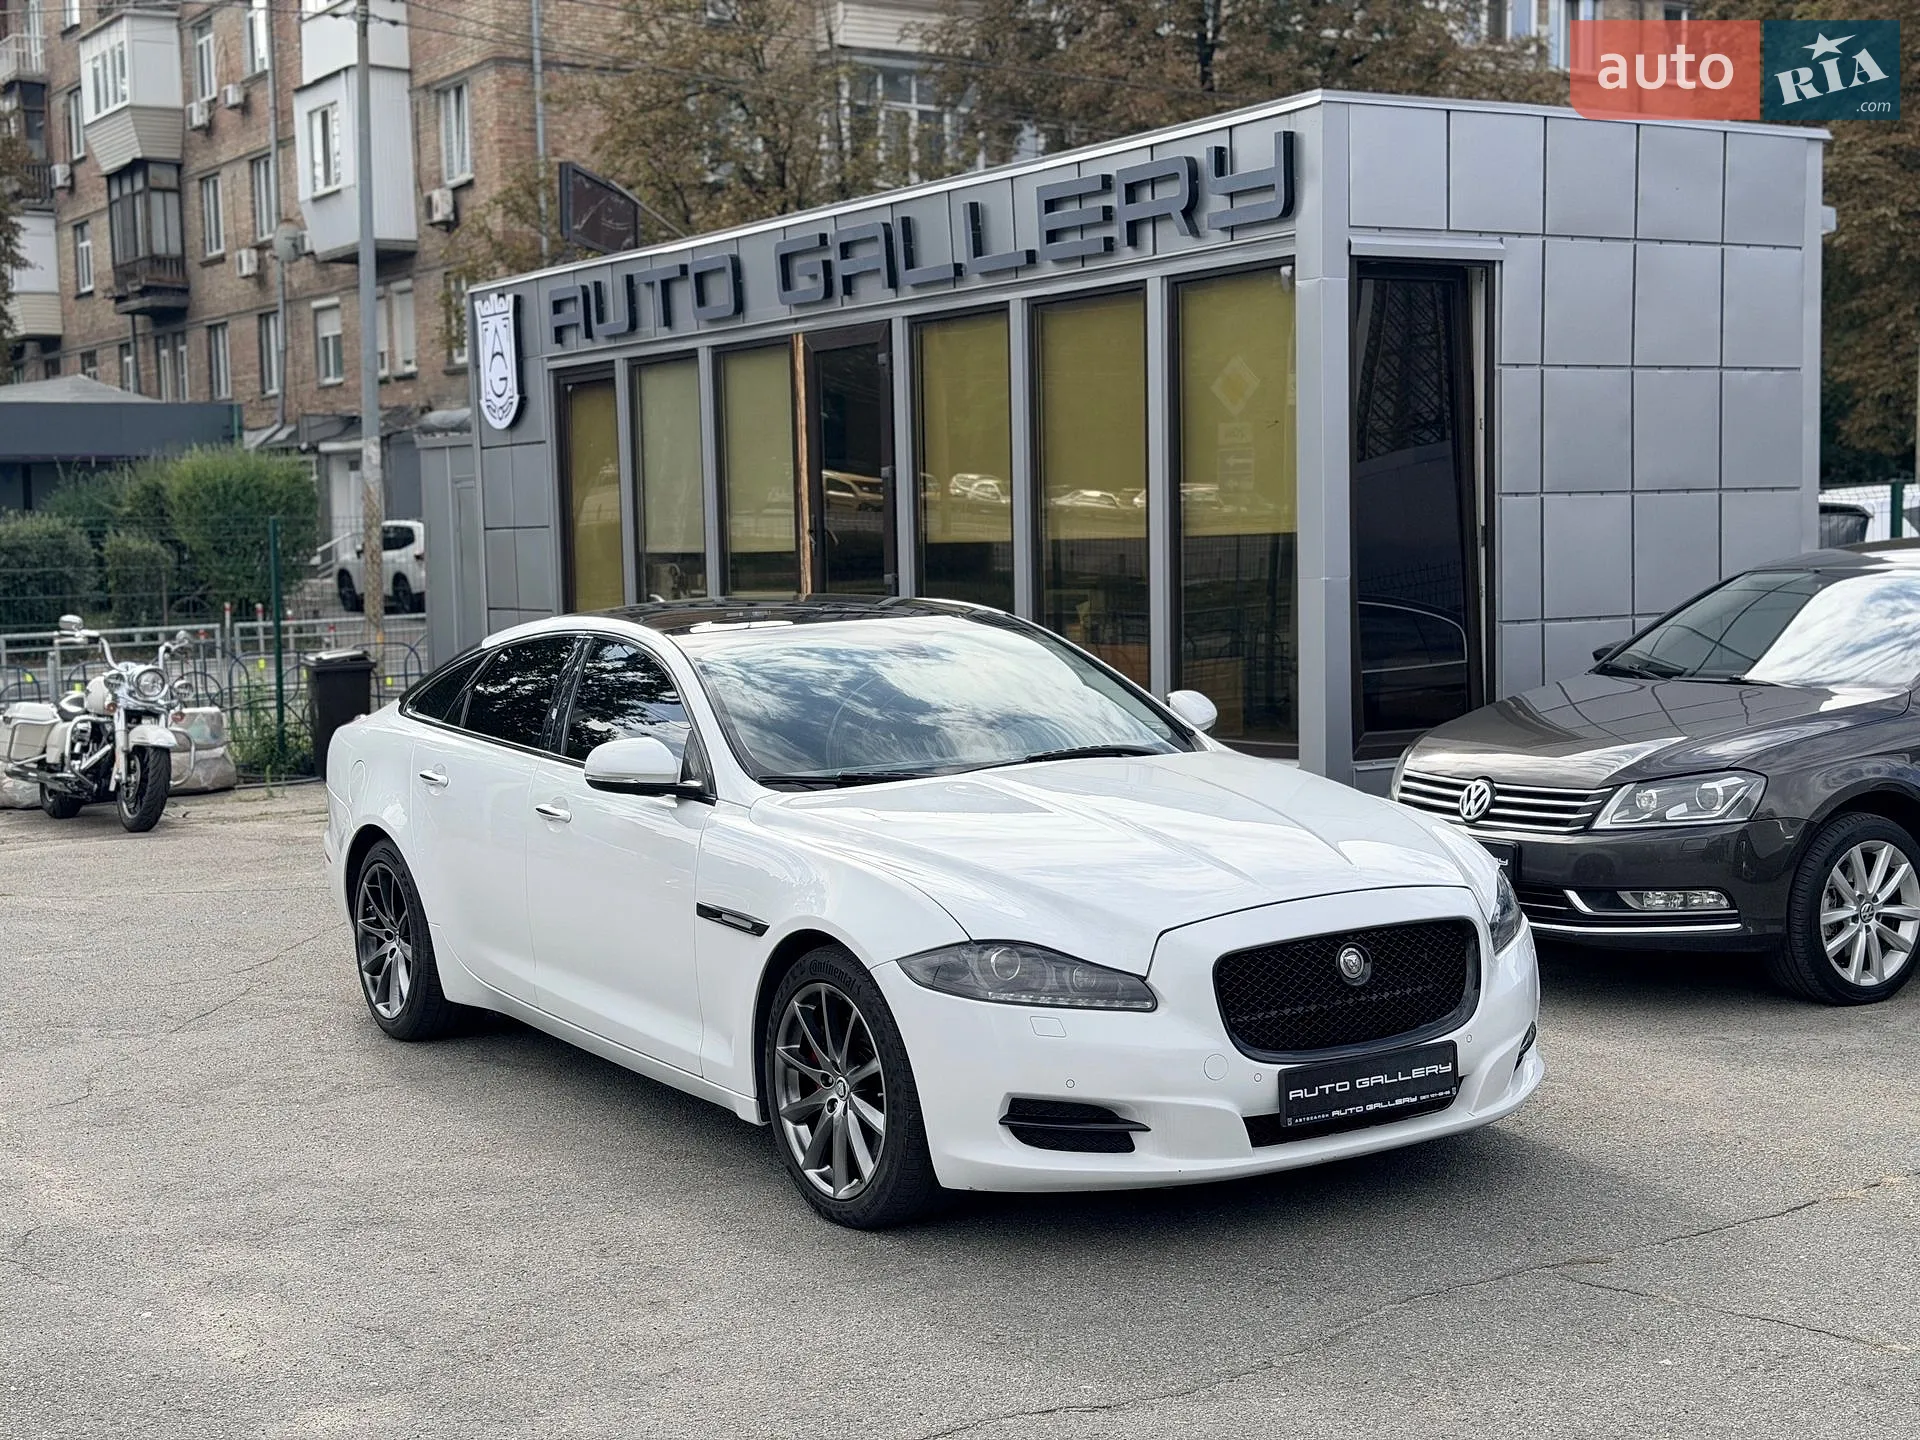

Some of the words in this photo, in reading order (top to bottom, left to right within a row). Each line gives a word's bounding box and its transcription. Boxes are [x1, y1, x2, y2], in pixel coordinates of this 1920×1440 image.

[547, 254, 742, 346] AUTO
[774, 130, 1296, 304] GALLERY
[1289, 1081, 1350, 1101] AUTO
[1355, 1062, 1453, 1089] GALLERY
[1331, 1105, 1364, 1118] AUTO
[1365, 1095, 1418, 1111] GALLERY
